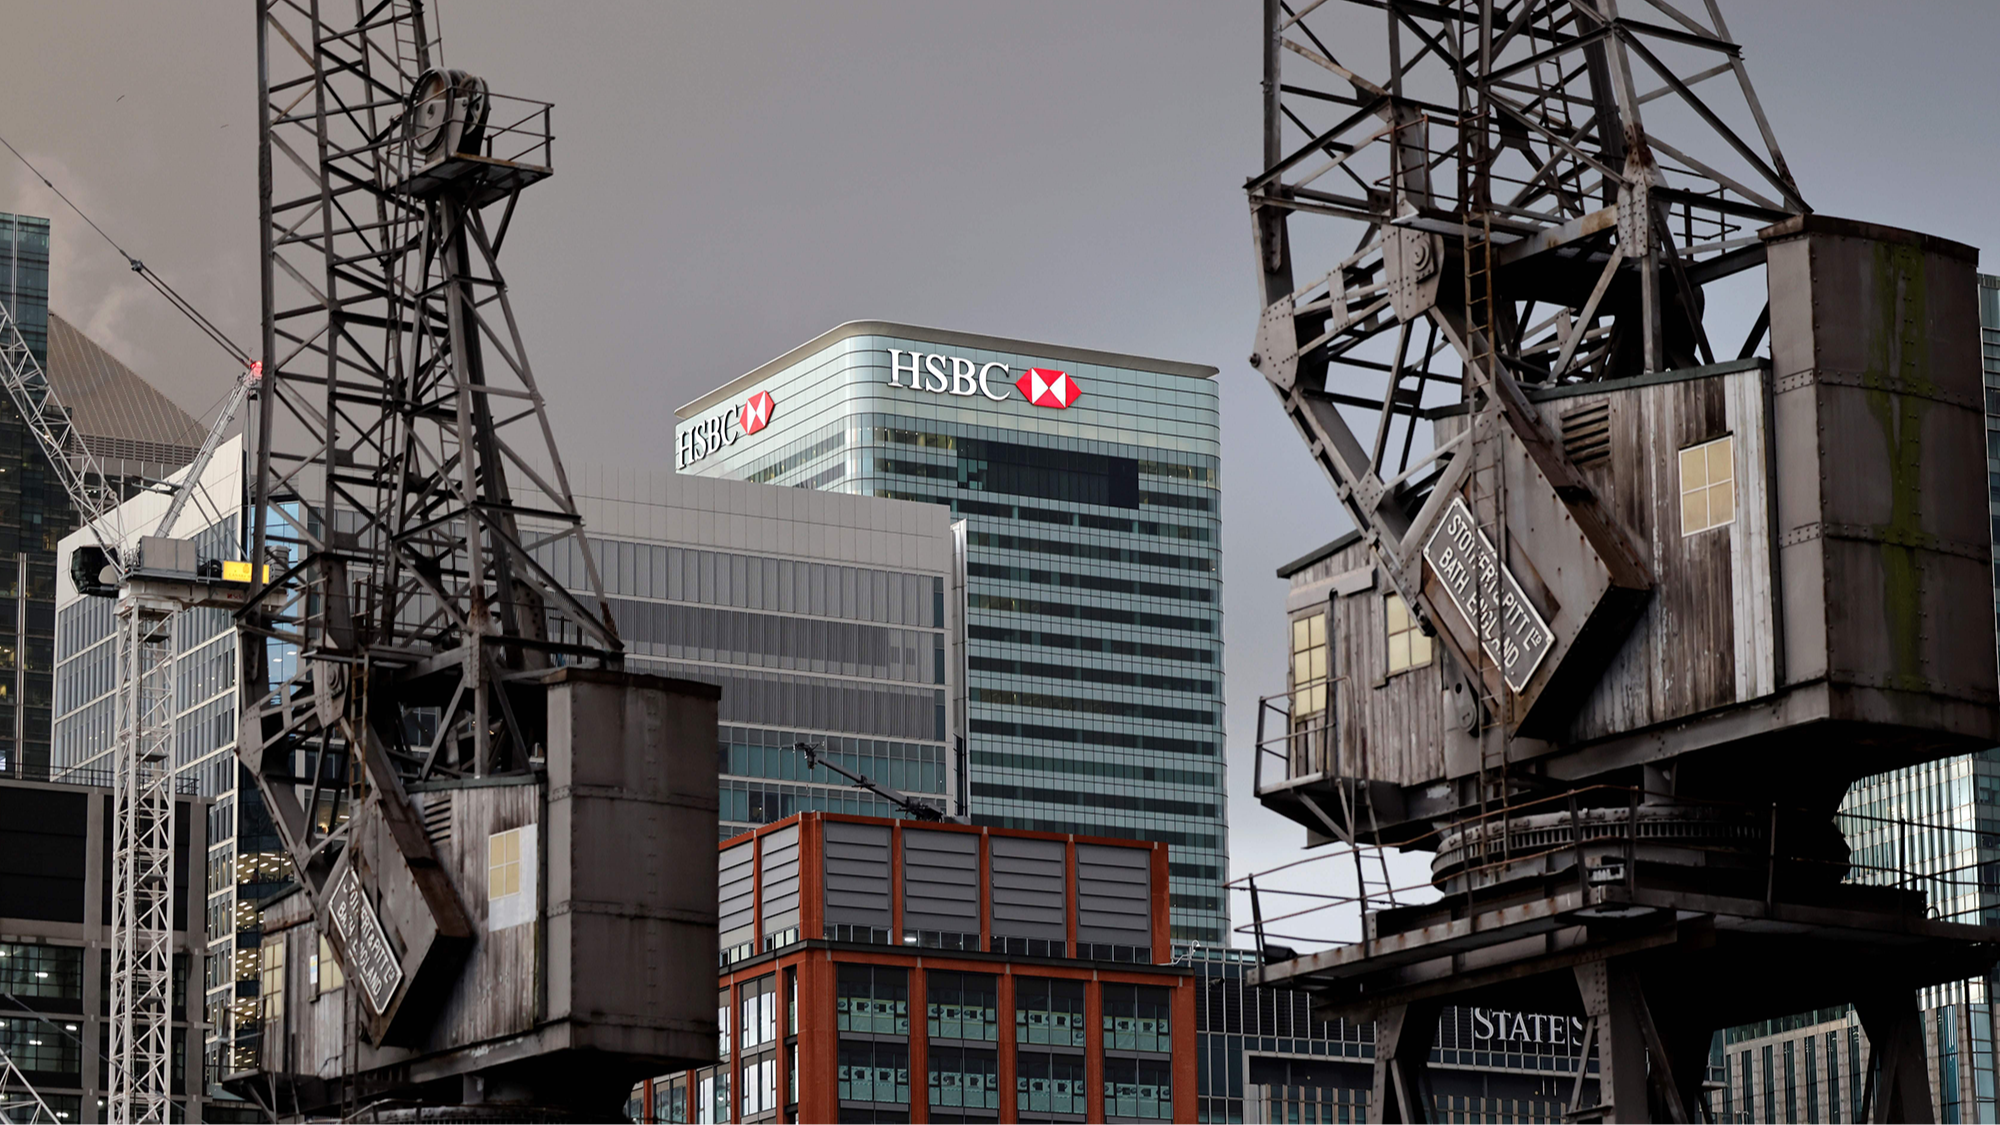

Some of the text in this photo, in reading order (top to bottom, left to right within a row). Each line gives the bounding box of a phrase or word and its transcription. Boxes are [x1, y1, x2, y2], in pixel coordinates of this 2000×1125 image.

[887, 348, 1011, 401] HSBC
[677, 404, 739, 470] HSBC
[1502, 592, 1531, 635] PITT
[1474, 1007, 1566, 1045] STATE
